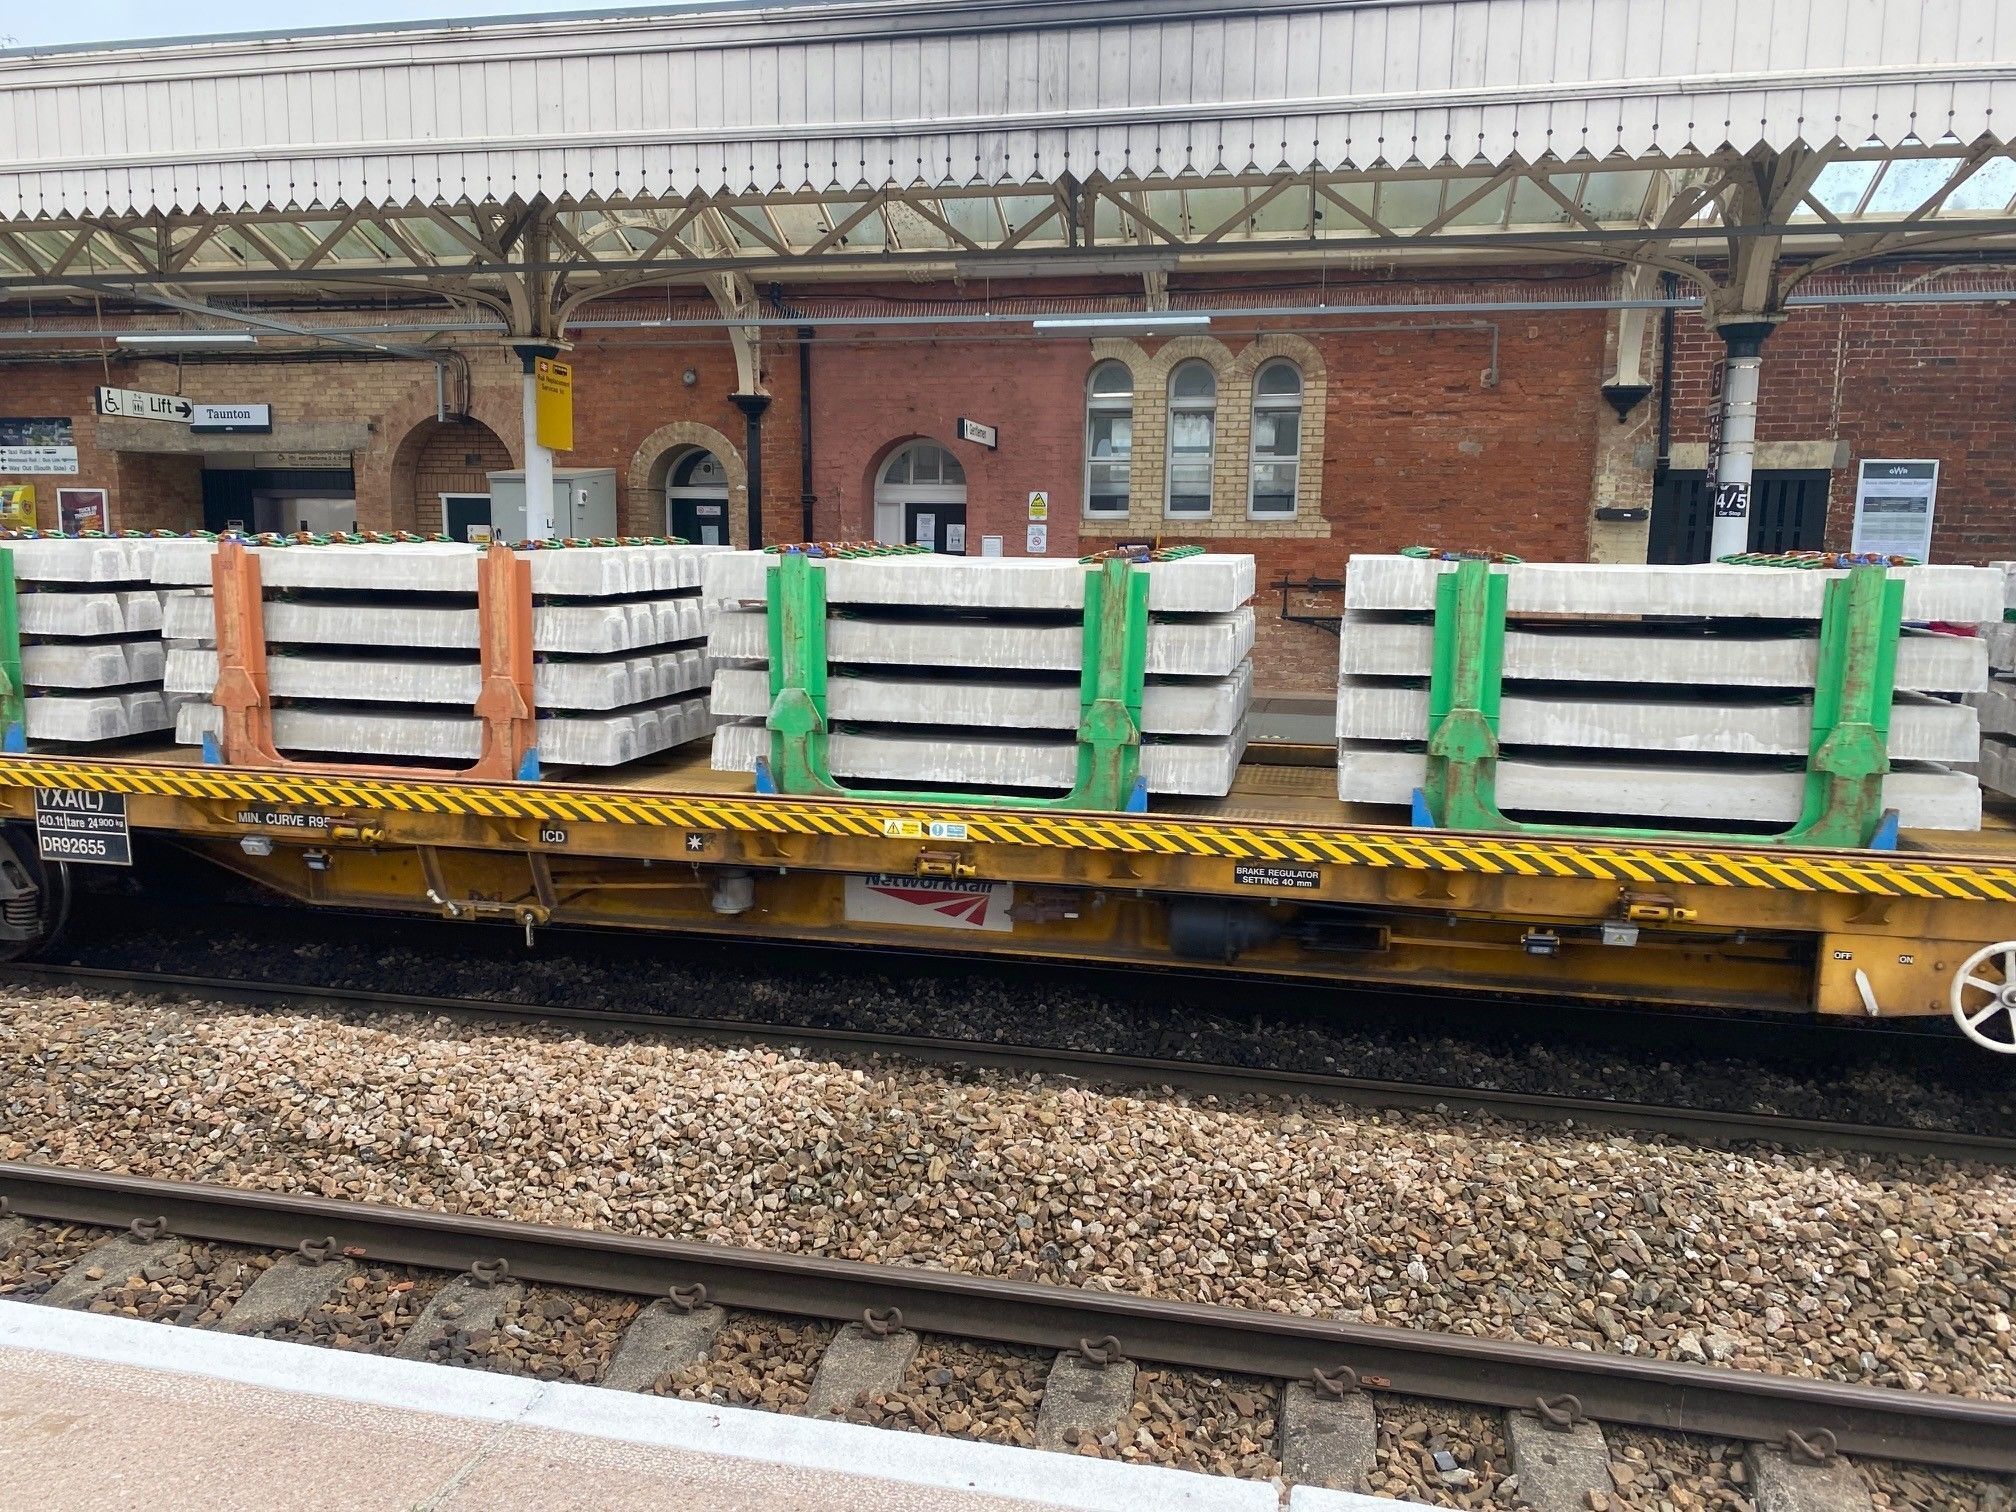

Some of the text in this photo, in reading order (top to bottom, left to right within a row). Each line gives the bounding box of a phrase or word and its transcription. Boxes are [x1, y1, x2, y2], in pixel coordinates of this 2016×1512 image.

[150, 397, 172, 414] Lift
[206, 409, 251, 419] Taunton
[1716, 492, 1747, 509] 4/5
[40, 788, 104, 812] YXA(L)
[40, 814, 64, 827] 40.1t
[67, 817, 86, 828] tare
[115, 819, 124, 828] kg
[238, 811, 262, 823] MIN.
[265, 813, 305, 827] CURVE
[542, 830, 565, 842] ICD
[41, 836, 106, 856] DR92655
[1236, 867, 1319, 879] BRAKE REGULATOR
[1242, 875, 1312, 888] SETTING 40 mm
[1834, 951, 1853, 960] OFF
[1899, 956, 1914, 964] ON
